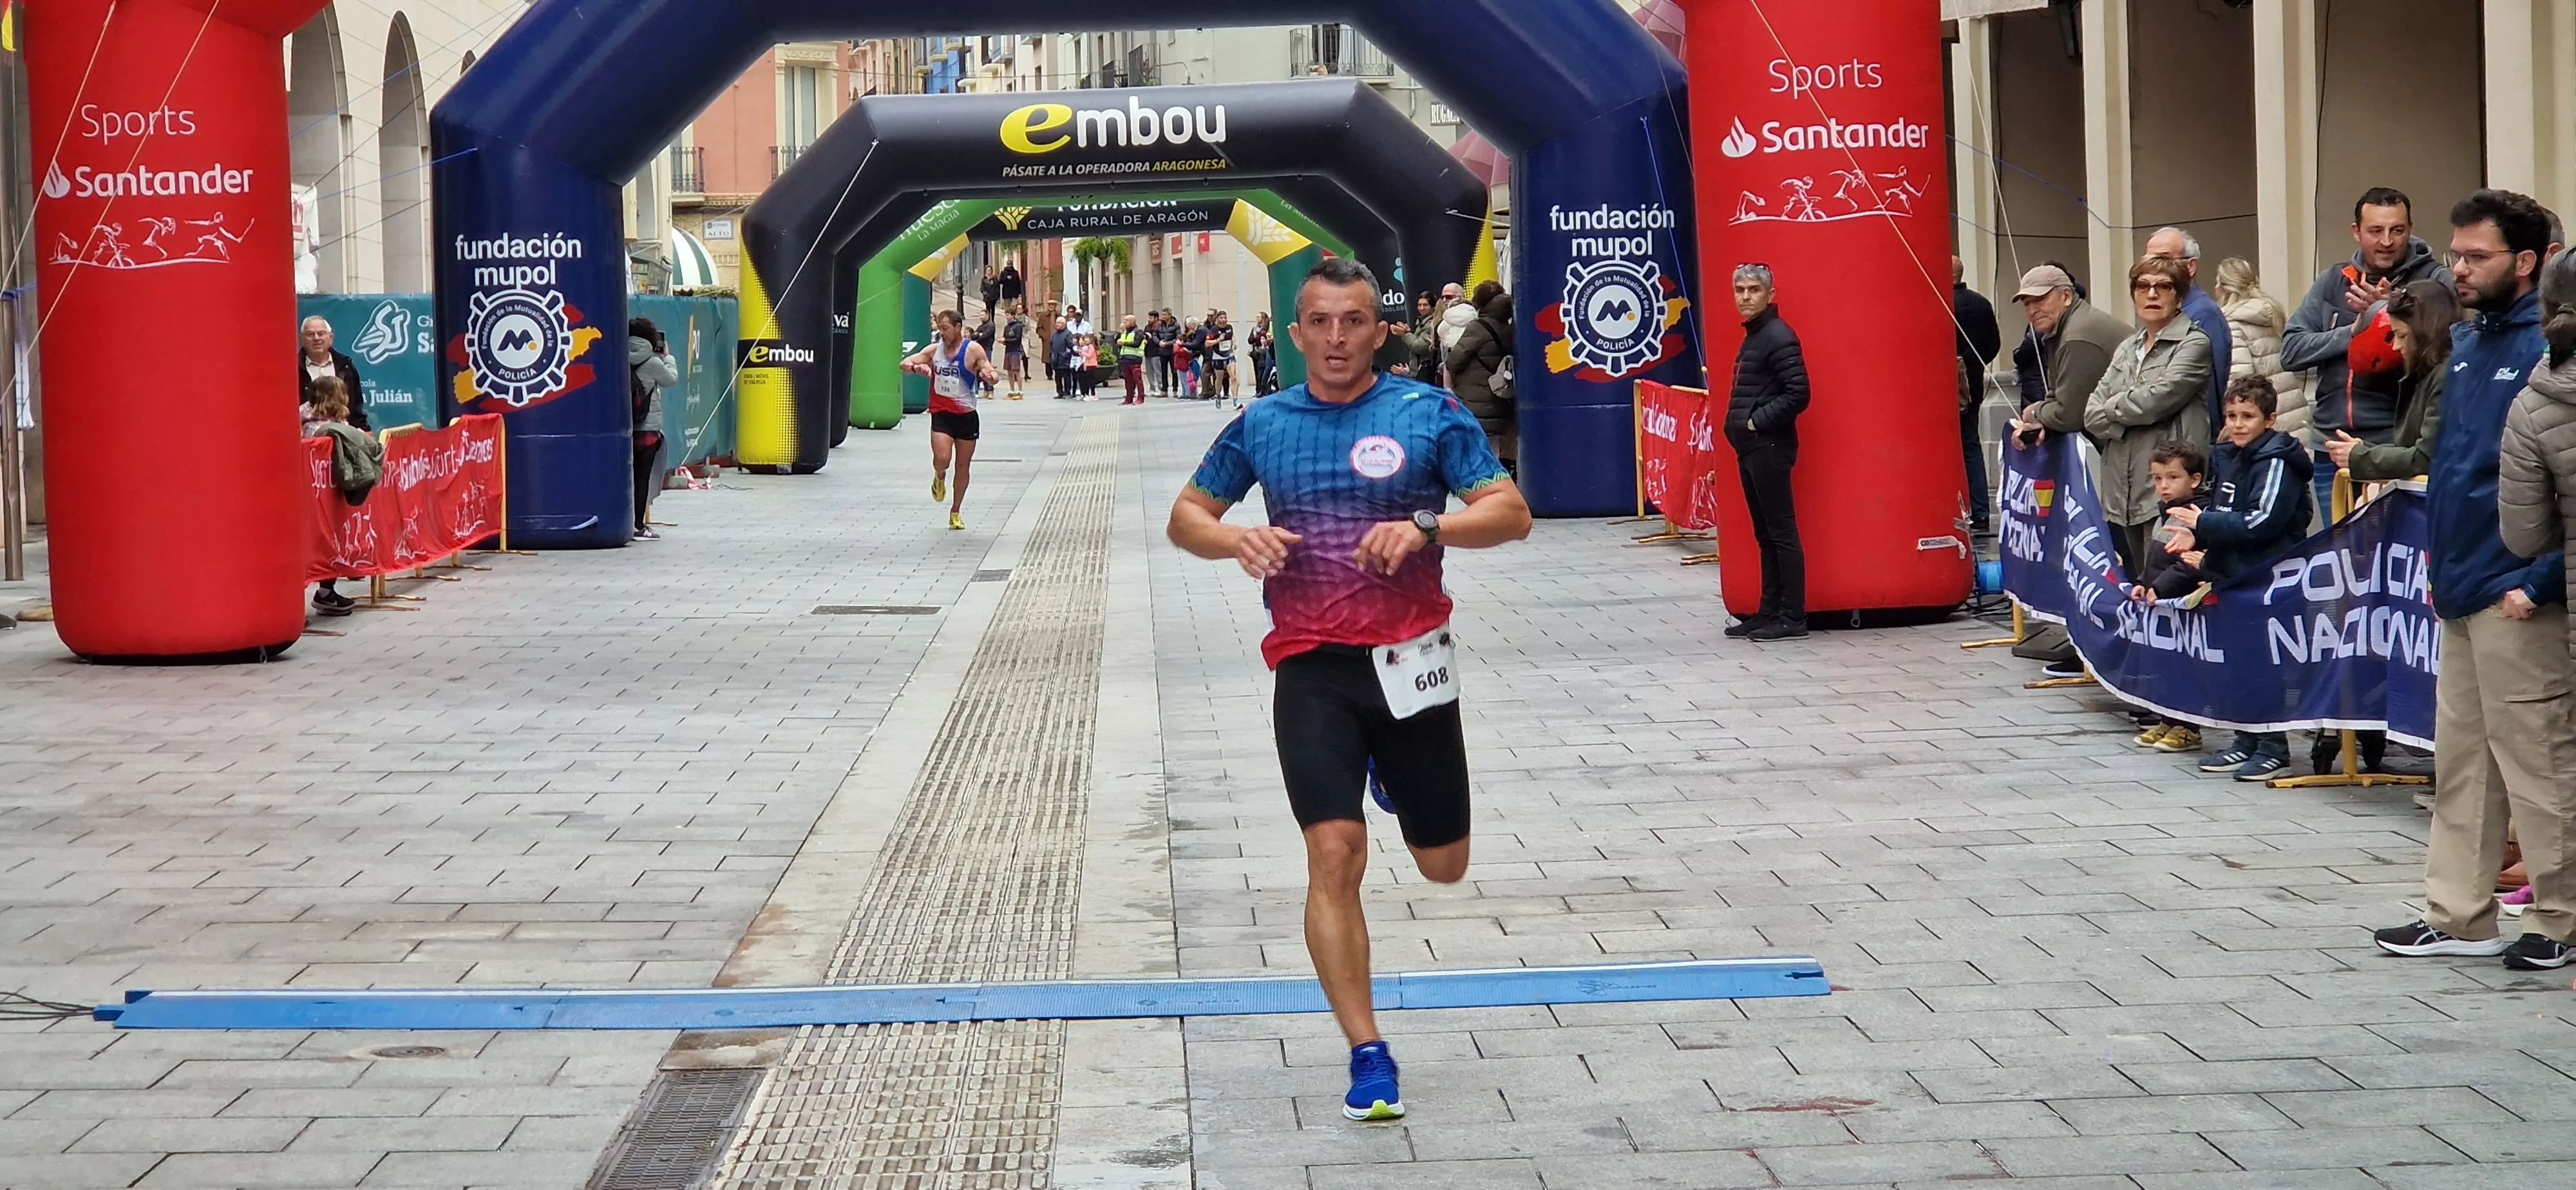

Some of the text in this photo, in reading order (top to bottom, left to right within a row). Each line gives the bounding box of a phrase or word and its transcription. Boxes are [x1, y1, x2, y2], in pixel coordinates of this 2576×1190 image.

[1768, 57, 1883, 99] Sports
[80, 103, 196, 145] Sports
[999, 95, 1227, 154] embou
[1762, 117, 1929, 153] Santander
[74, 162, 254, 197] Santander
[1002, 159, 1226, 177] PÁSATE A LA OPERADORA ARAGONESA
[1027, 209, 1209, 229] CAJA RURAL DE ARAGÓN
[1549, 203, 1675, 231] fundación
[455, 231, 582, 260] fundación
[1571, 230, 1653, 260] mupol
[475, 259, 556, 290] mupol
[1578, 285, 1595, 319] Fundación
[1613, 274, 1647, 299] Mutualidad
[1643, 299, 1650, 309] de
[481, 314, 497, 349] Fundación
[515, 304, 551, 328] Mutualidad
[545, 329, 553, 339] de
[749, 343, 814, 363] embou
[1596, 338, 1635, 350] POLICÍA
[498, 368, 537, 380] POLICÍA
[934, 365, 960, 377] USA
[370, 388, 413, 406] Julián
[2268, 605, 2441, 676] NACIONAL
[1414, 666, 1449, 691] 608
